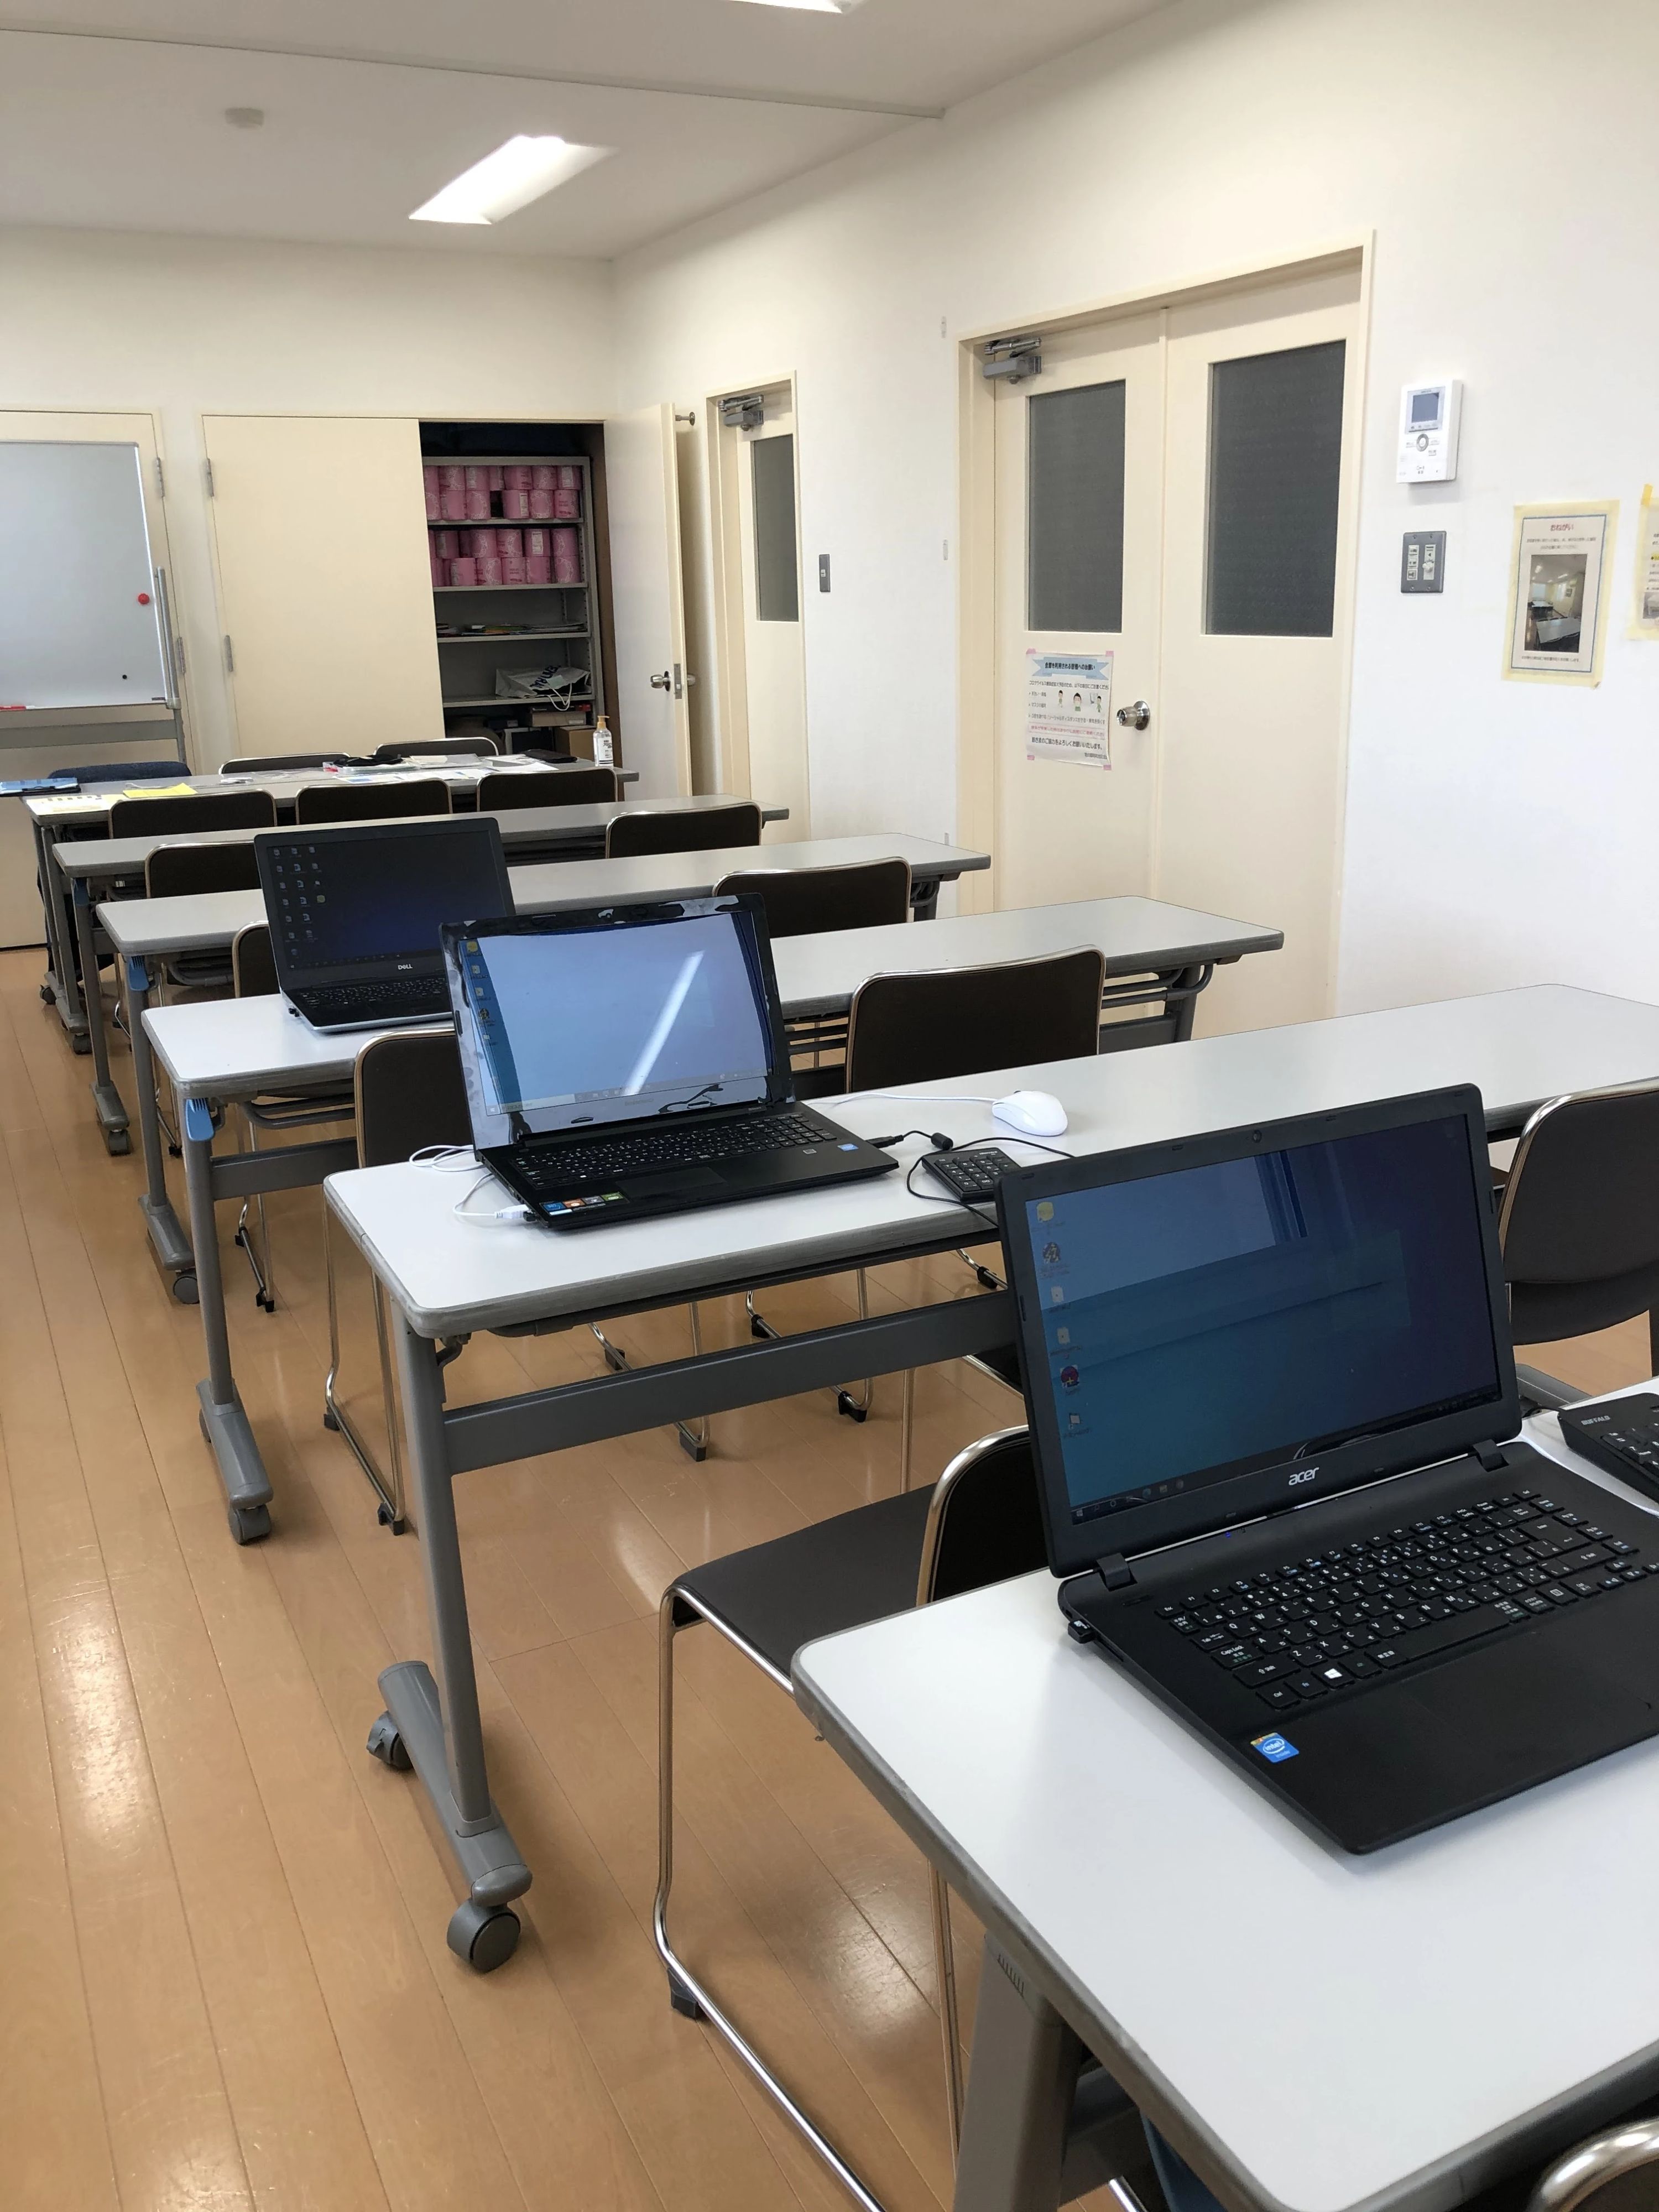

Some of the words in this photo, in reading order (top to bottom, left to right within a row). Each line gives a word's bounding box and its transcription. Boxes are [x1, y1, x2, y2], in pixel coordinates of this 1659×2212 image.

[1580, 1415, 1611, 1425] BUFFALO
[1288, 1467, 1319, 1486] acer
[1265, 1740, 1283, 1751] intel
